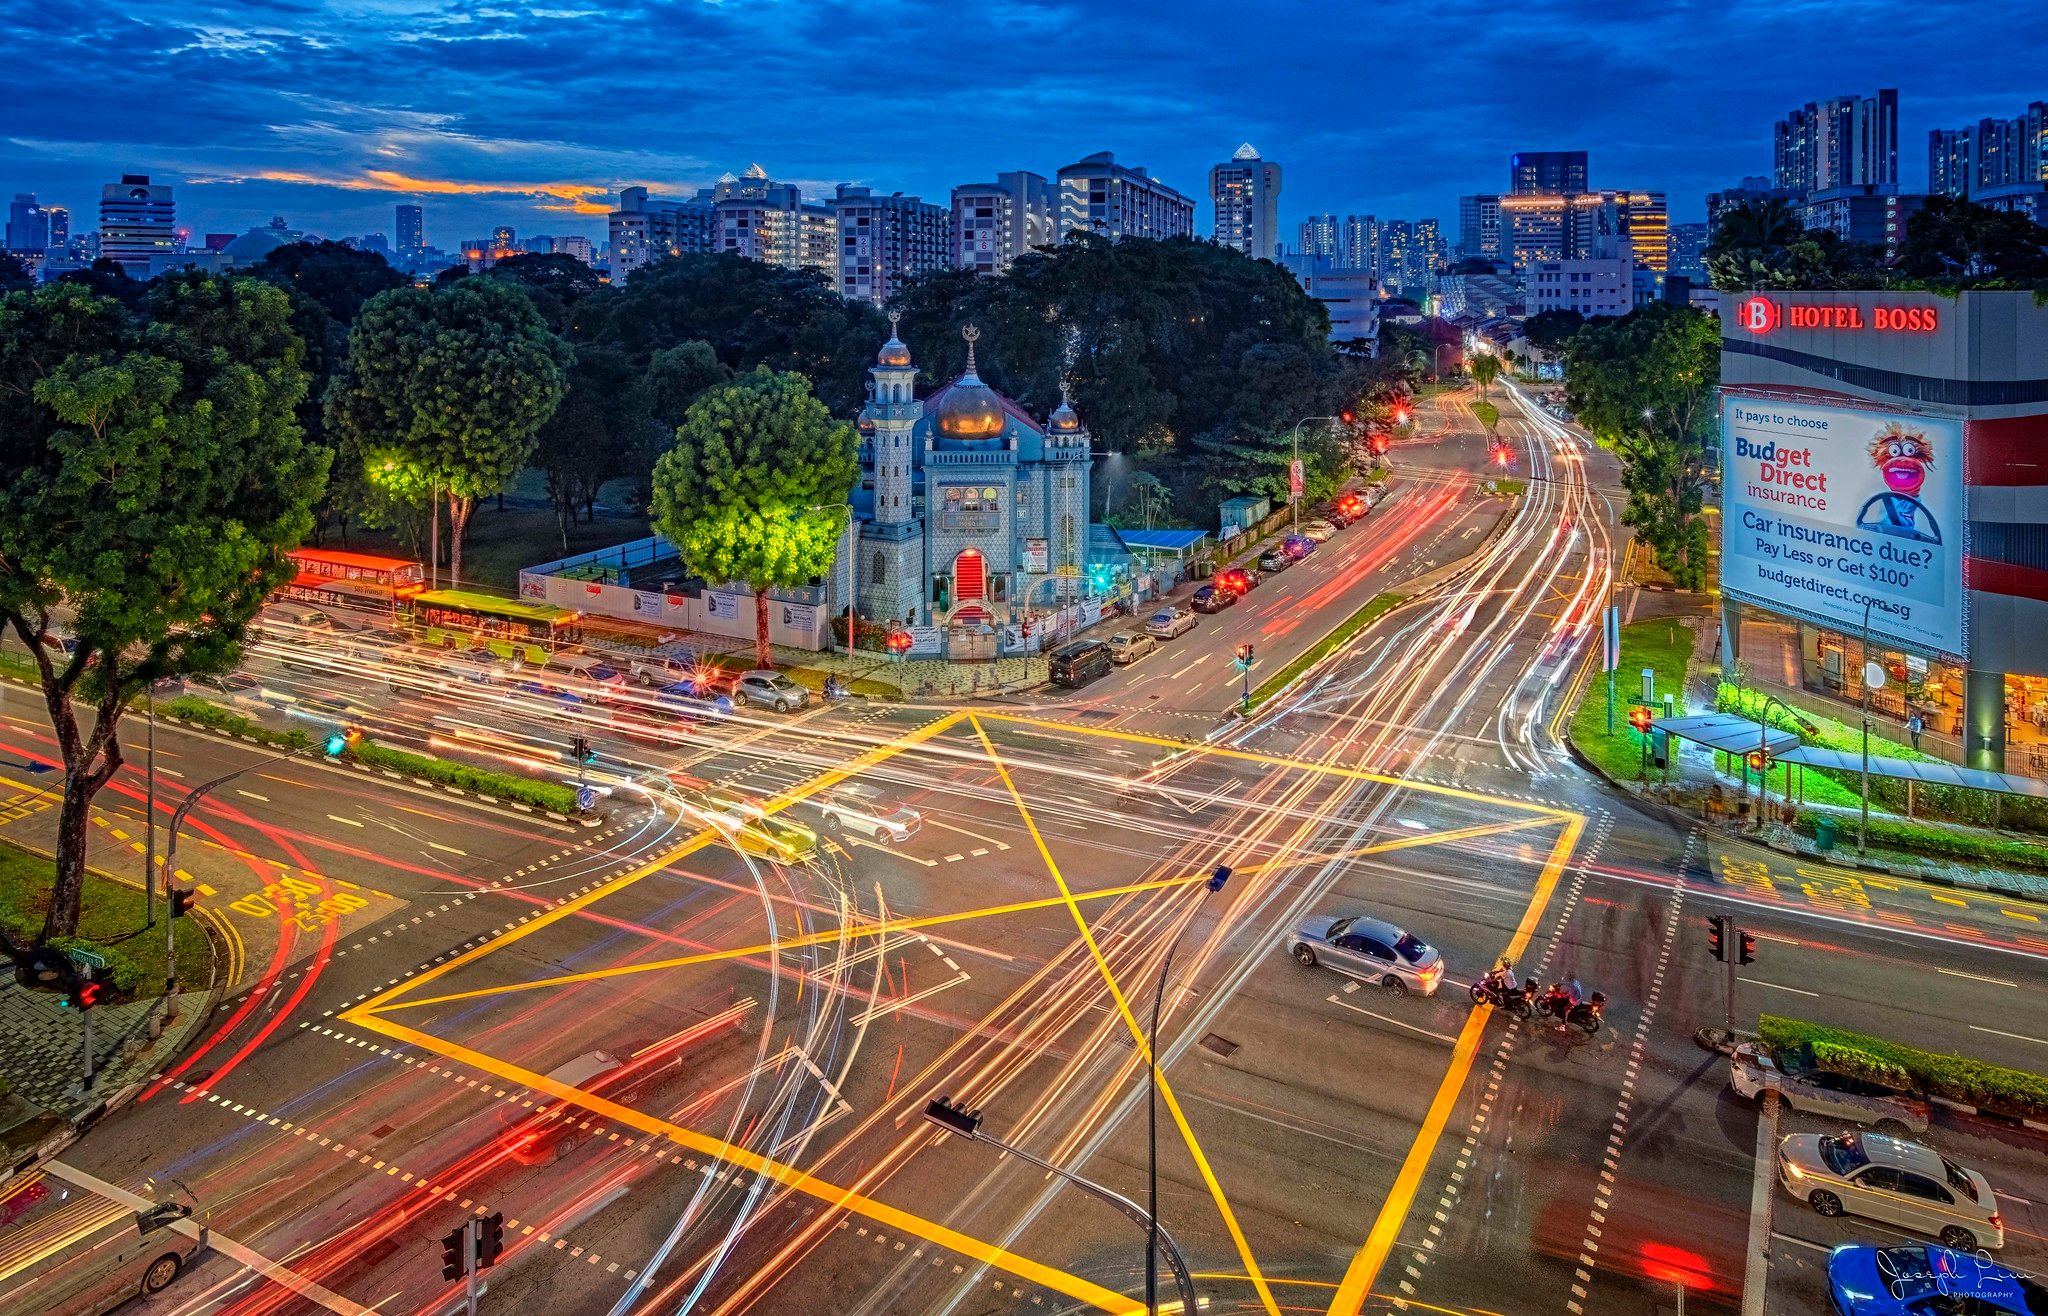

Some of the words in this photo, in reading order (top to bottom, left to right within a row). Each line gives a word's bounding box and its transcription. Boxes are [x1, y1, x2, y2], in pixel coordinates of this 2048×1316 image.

[1790, 306, 1864, 328] HOTEL
[1873, 307, 1936, 331] BOSS
[1735, 408, 1743, 420] It
[1746, 412, 1770, 424] pays
[1773, 414, 1784, 424] to
[1787, 416, 1828, 430] choose
[1735, 436, 1811, 469] Budget
[1760, 462, 1827, 493] Direct
[1747, 481, 1827, 511] insurance
[1743, 510, 1773, 537] Car
[1777, 519, 1873, 557] insurance
[1878, 541, 1933, 570] due?
[1755, 537, 1780, 559] Pay
[1783, 544, 1814, 564] Less
[1817, 555, 1834, 569] or
[1837, 557, 1865, 578] Get
[1757, 564, 1911, 621] budgetdirect.comsg
